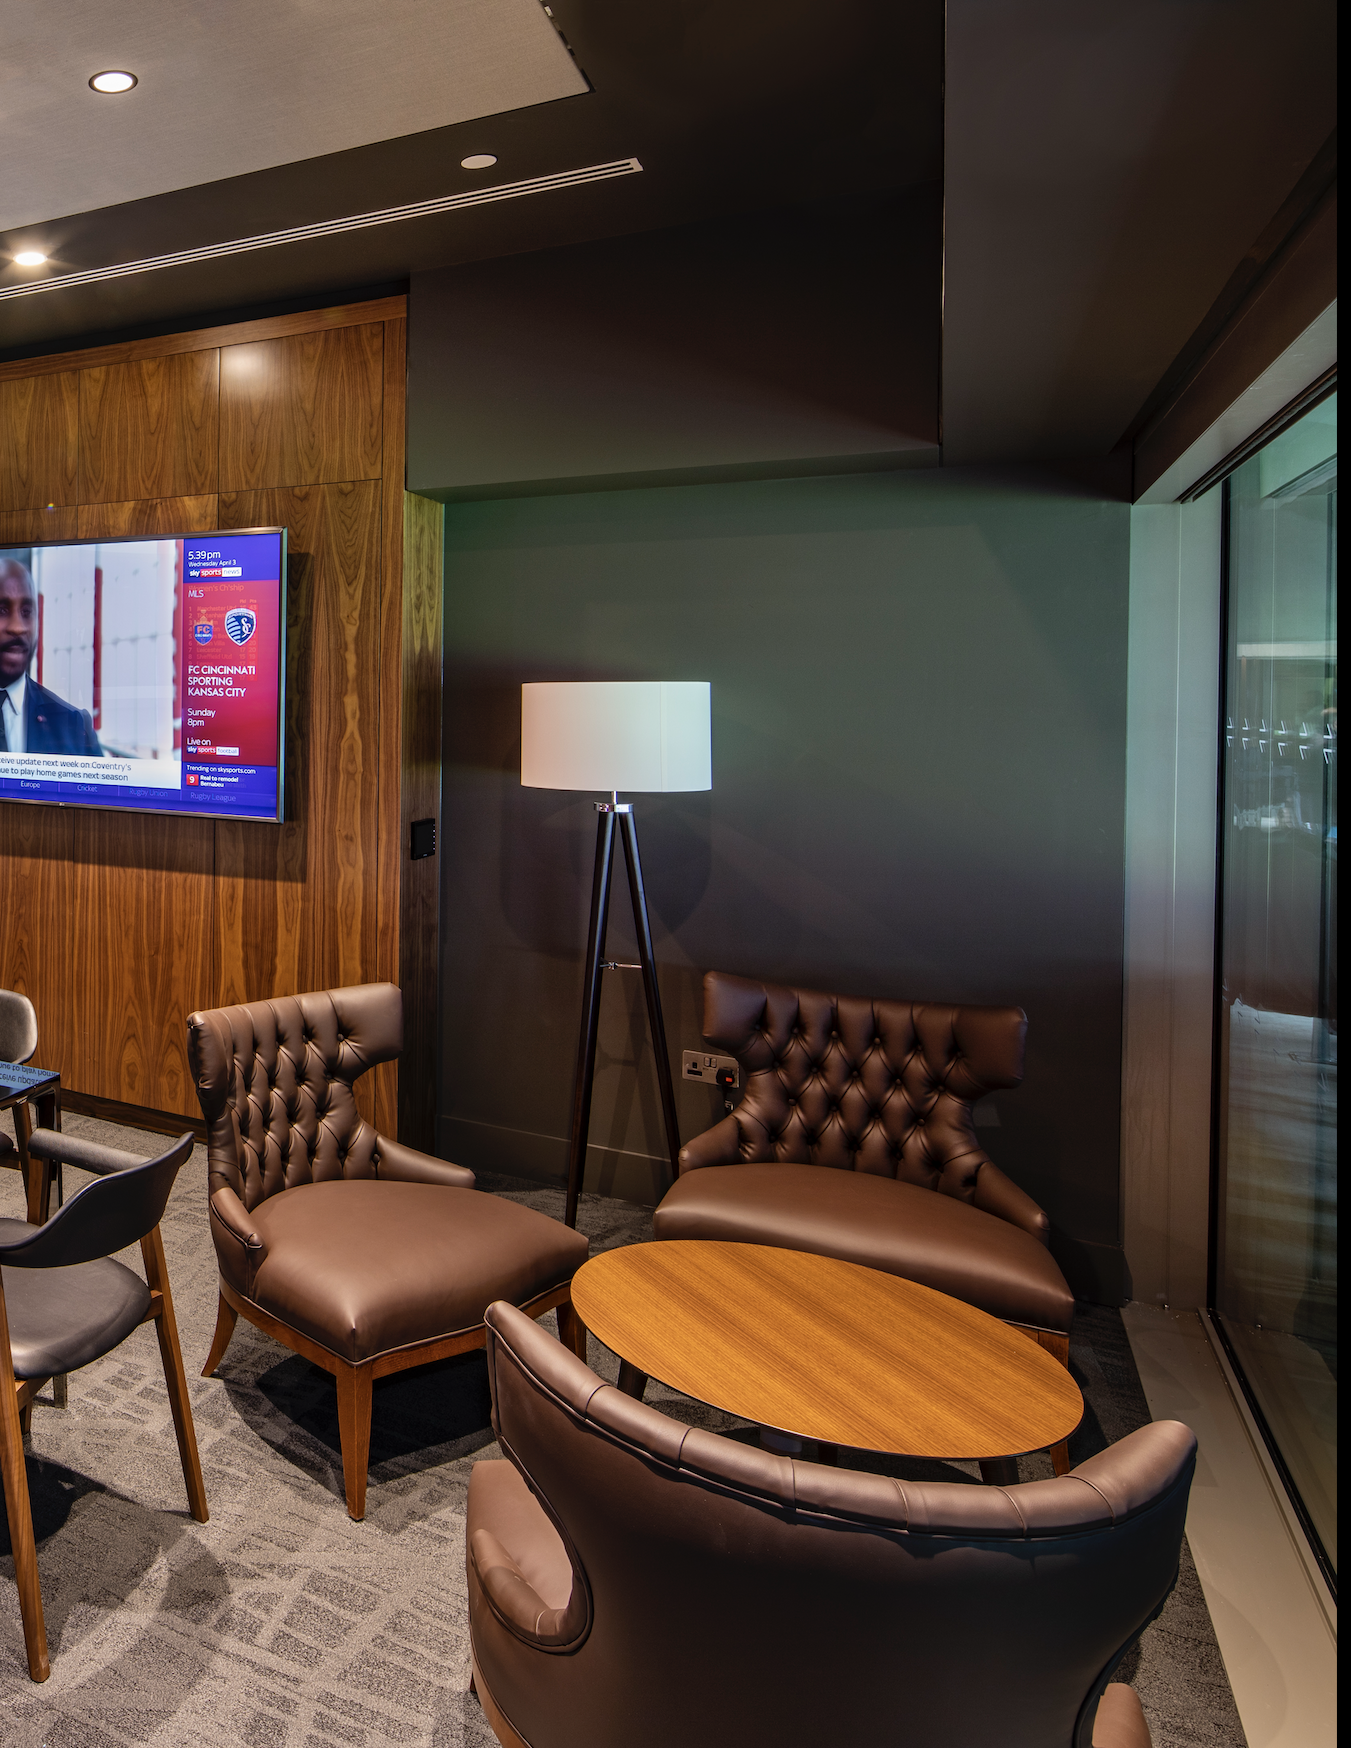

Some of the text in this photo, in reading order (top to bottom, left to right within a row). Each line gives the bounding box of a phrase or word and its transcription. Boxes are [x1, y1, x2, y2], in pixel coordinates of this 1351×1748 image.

[188, 550, 221, 560] 5.39pm
[219, 559, 231, 567] April
[189, 568, 240, 577] sky sports news
[188, 590, 204, 598] MLS
[197, 626, 210, 634] FC
[188, 665, 255, 675] FC CINCINNATI
[188, 677, 233, 686] SPORTING
[188, 688, 246, 697] KANSAS CITY
[187, 708, 216, 718] Sunday
[187, 718, 205, 727] 8pm
[187, 738, 201, 746] Live
[17, 758, 41, 766] update
[60, 760, 79, 768] week
[91, 762, 132, 771] Coventry's
[20, 767, 35, 776] play
[58, 771, 82, 779] games
[20, 781, 41, 789] Europe
[77, 784, 98, 792] Cricket
[130, 788, 168, 797] Rugby Union
[190, 792, 236, 802] Rugby League
